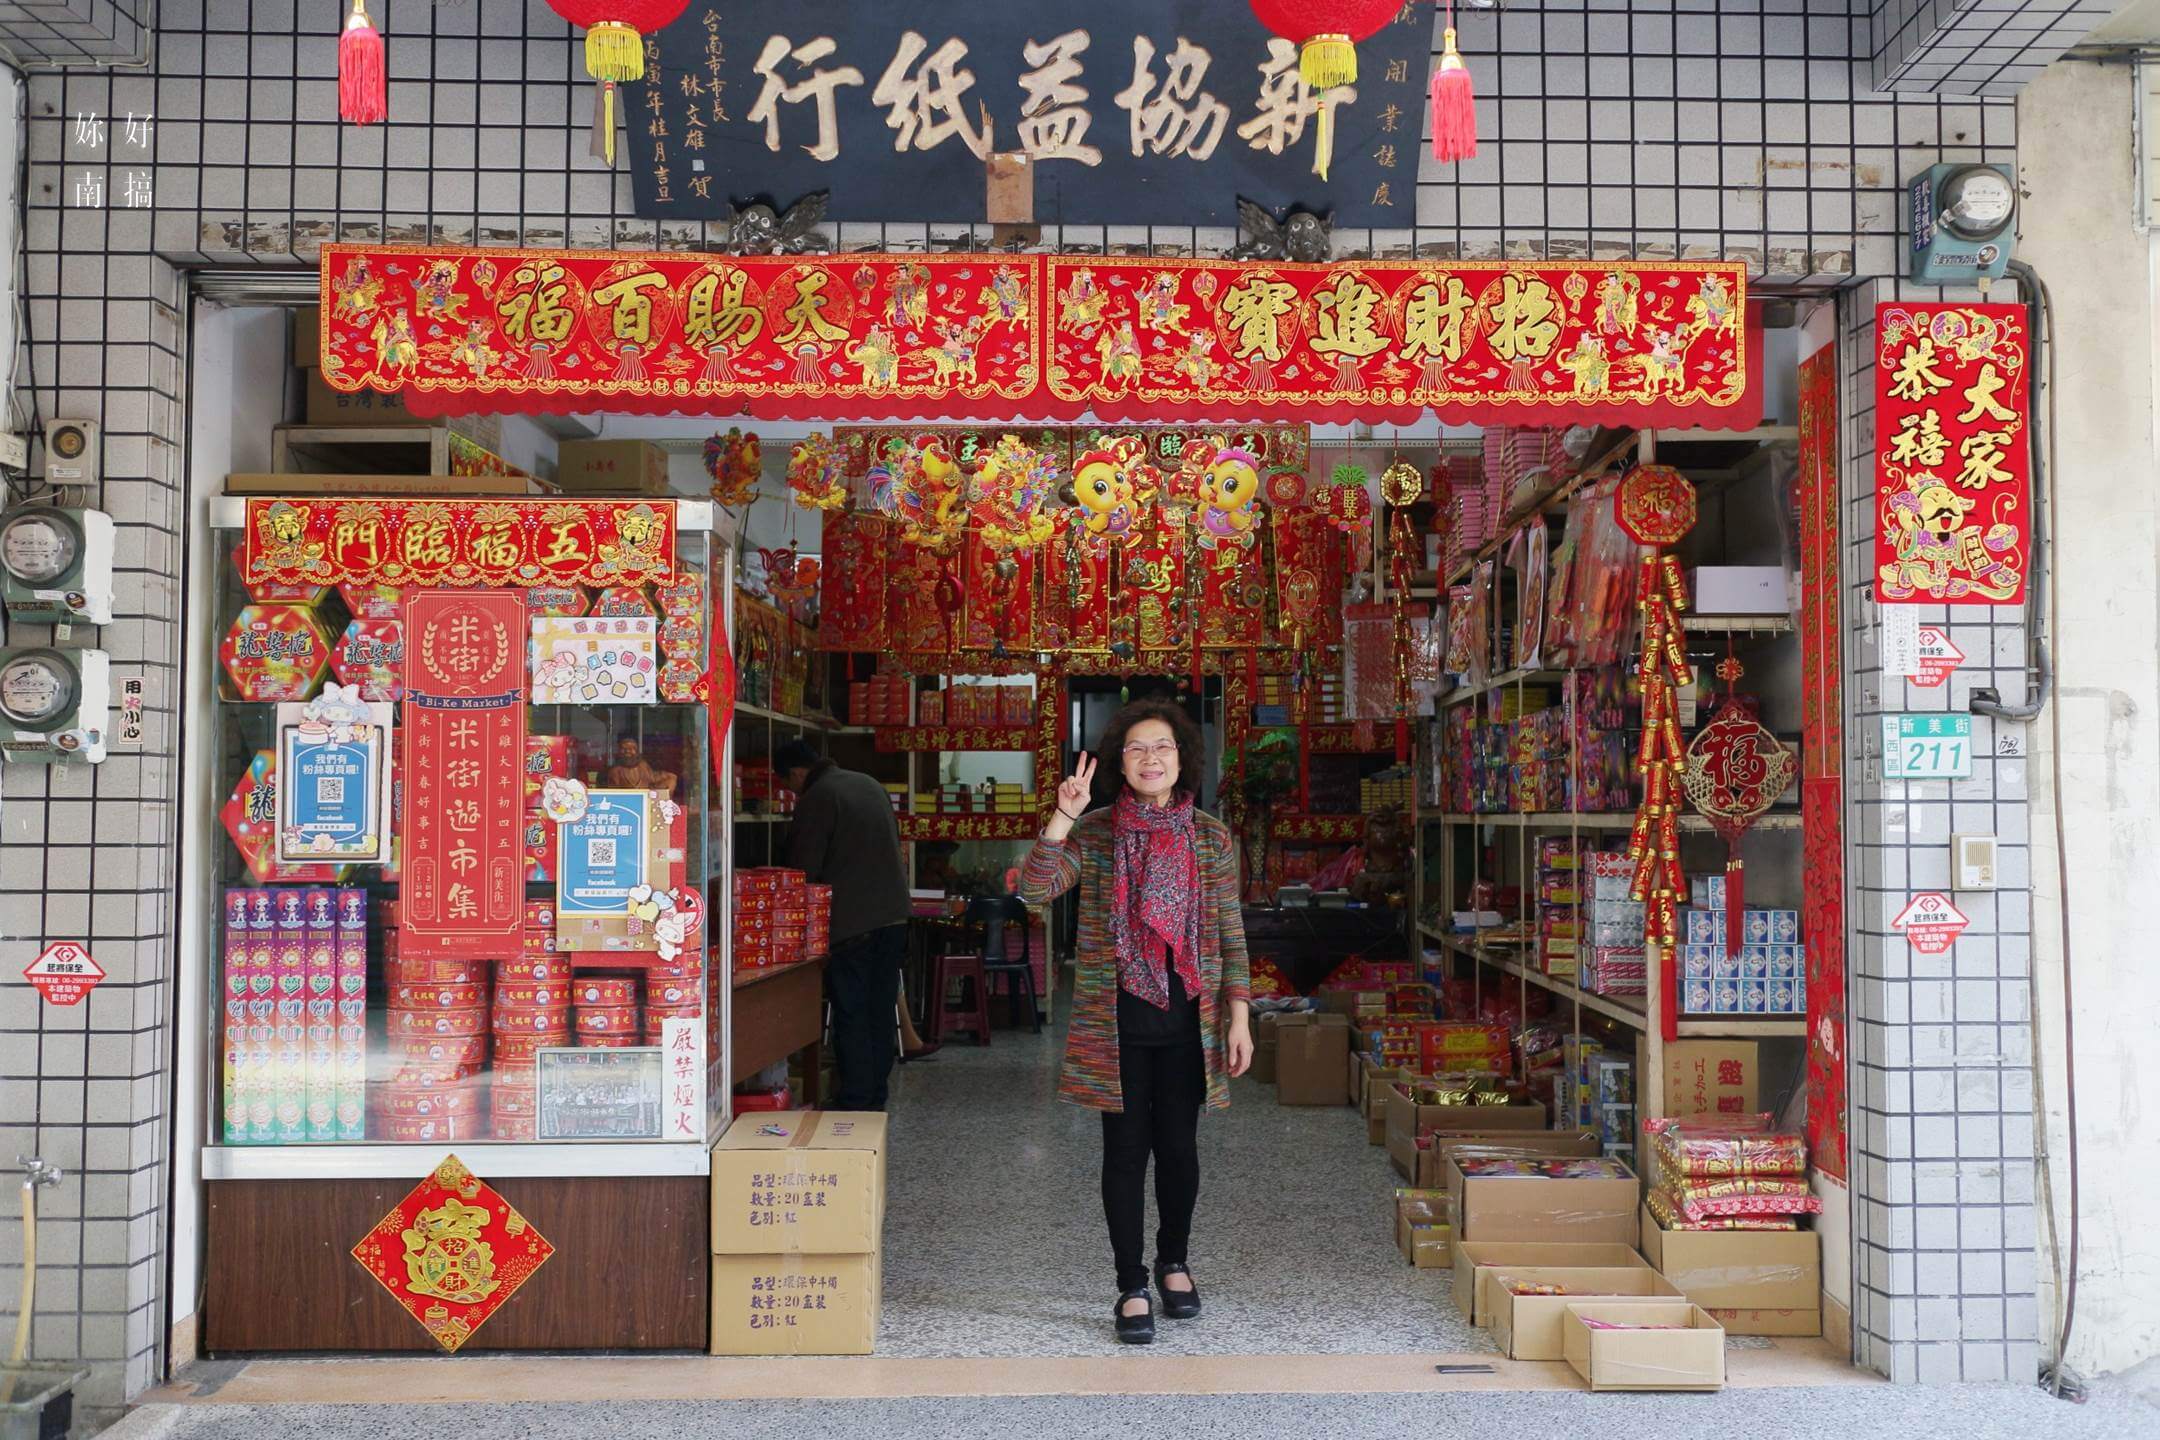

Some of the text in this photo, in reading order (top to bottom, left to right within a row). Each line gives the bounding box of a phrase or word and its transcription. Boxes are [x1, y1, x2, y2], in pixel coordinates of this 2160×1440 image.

[703, 9, 730, 122] 台南市市長
[747, 29, 1357, 167] 新協益紙行
[644, 32, 674, 202] 丙寅年桂月吉旦
[681, 73, 713, 199] 林文雄 賀
[498, 267, 850, 349] 天賜百福
[1221, 274, 1559, 361] 招財進寶
[1888, 338, 1953, 468] 恭禧
[1956, 364, 2017, 490] 大家
[334, 519, 590, 568] 五福臨門
[449, 615, 481, 673] 米街
[123, 680, 143, 740] 用火小心
[426, 697, 504, 709] Bi-Ke Market
[1901, 718, 1969, 734] 新美街
[315, 754, 347, 765] 我們有
[417, 714, 432, 850] 米街走春好事吉
[498, 714, 512, 849] 金雞大年初四五
[1702, 722, 1769, 788] 福
[1886, 720, 1899, 772] 中西區
[1907, 742, 1962, 770] 211
[446, 718, 481, 919] 米街遊市集
[585, 813, 620, 825] 我們有
[671, 1027, 696, 1135] 嚴禁煙火
